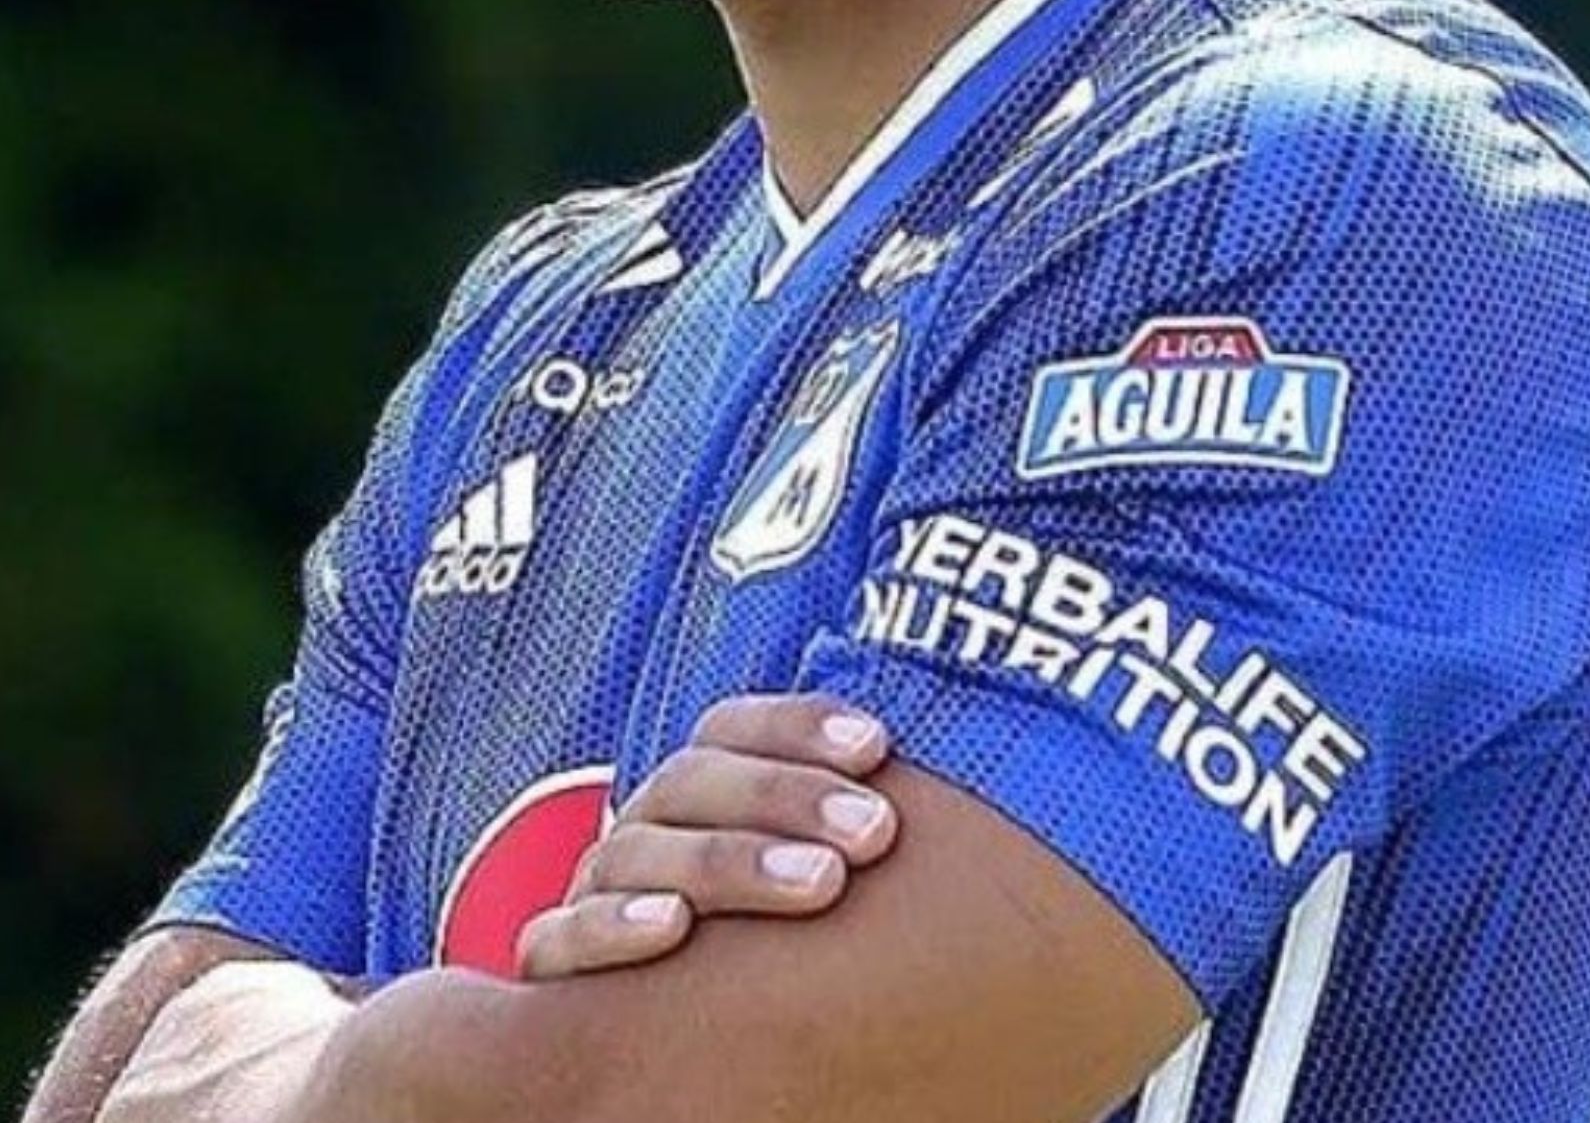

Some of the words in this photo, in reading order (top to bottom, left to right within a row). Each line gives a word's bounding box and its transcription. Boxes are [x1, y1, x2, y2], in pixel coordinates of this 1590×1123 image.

[1156, 330, 1240, 360] LIGA
[1041, 373, 1320, 468] AGUILA
[857, 576, 1319, 866] NUTRITION
